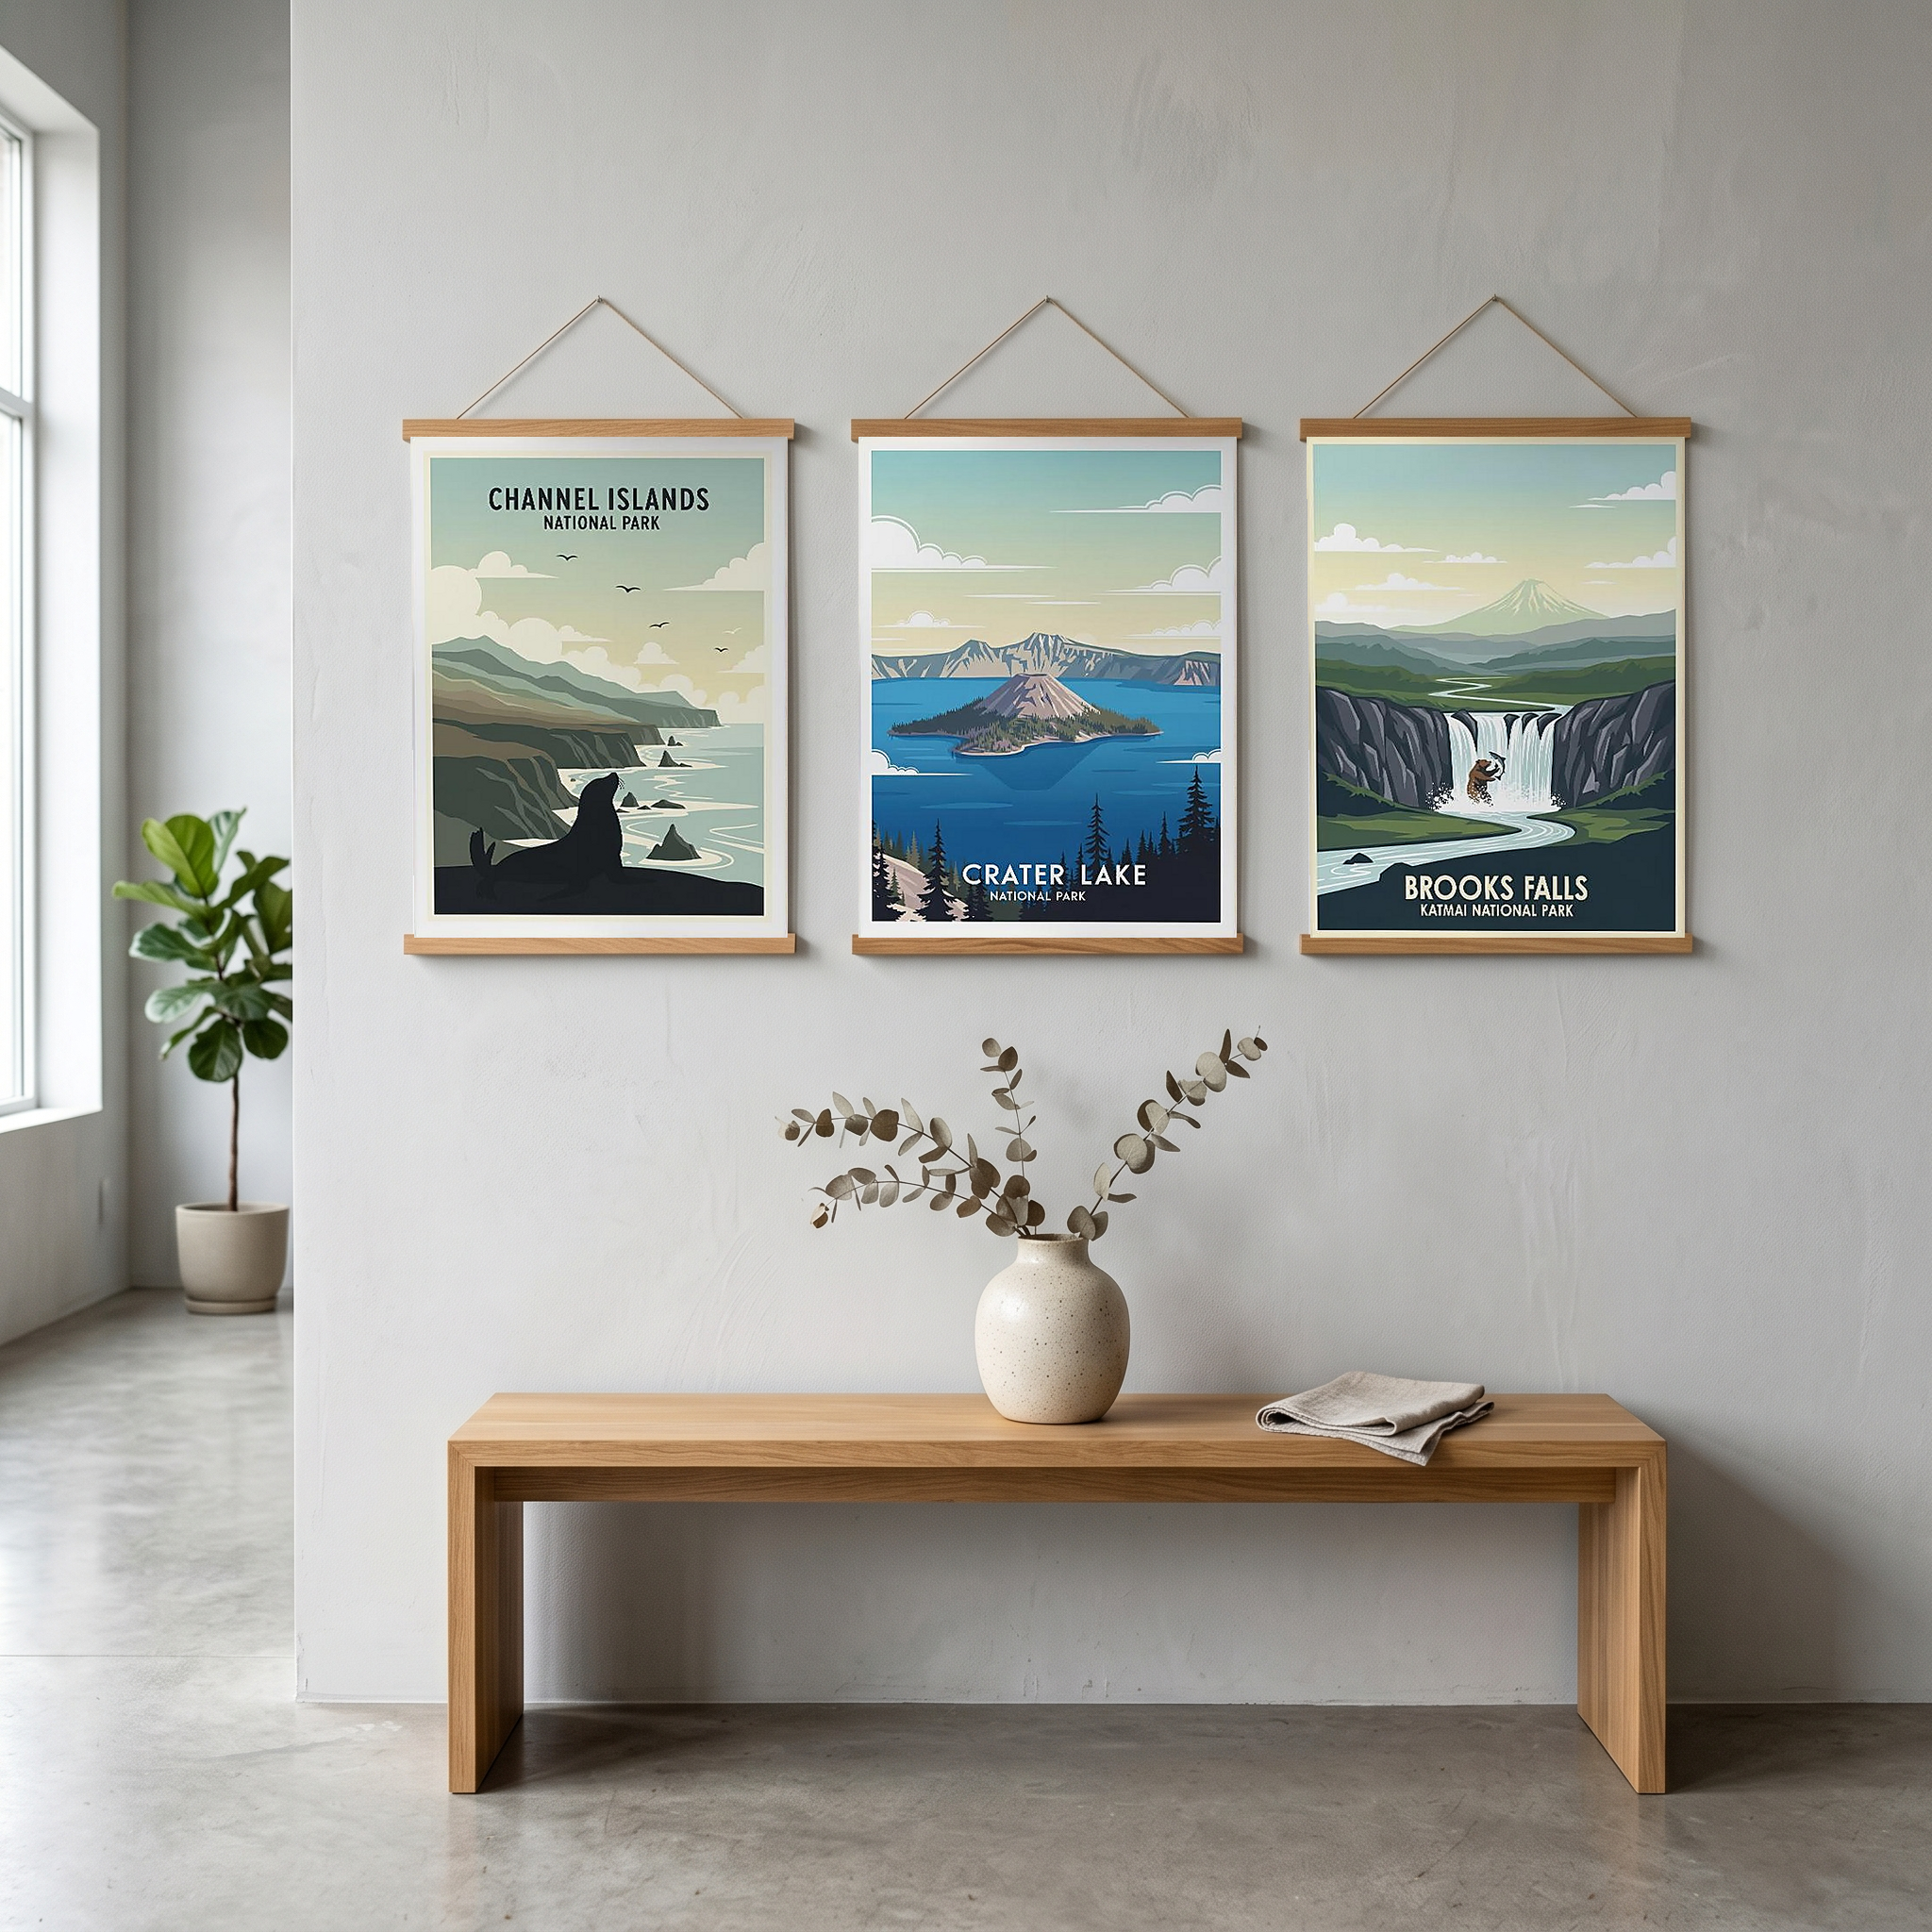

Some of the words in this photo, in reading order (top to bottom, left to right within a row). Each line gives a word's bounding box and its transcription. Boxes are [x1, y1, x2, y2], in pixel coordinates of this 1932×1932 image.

[488, 486, 599, 511] CHANNEL
[608, 486, 710, 511] ISLANDS
[543, 515, 618, 531] NATIONAL
[622, 515, 660, 531] PARK
[962, 863, 1064, 885] CRATER
[1081, 863, 1146, 885] LAKE
[990, 891, 1052, 902] NATIONAL
[1056, 891, 1086, 902] PARK
[1404, 874, 1514, 901] BROOKS
[1523, 874, 1589, 901] FALLS
[1420, 904, 1468, 918] KATMAI
[1472, 903, 1538, 918] NATIONAL
[1541, 903, 1574, 917] PARK
